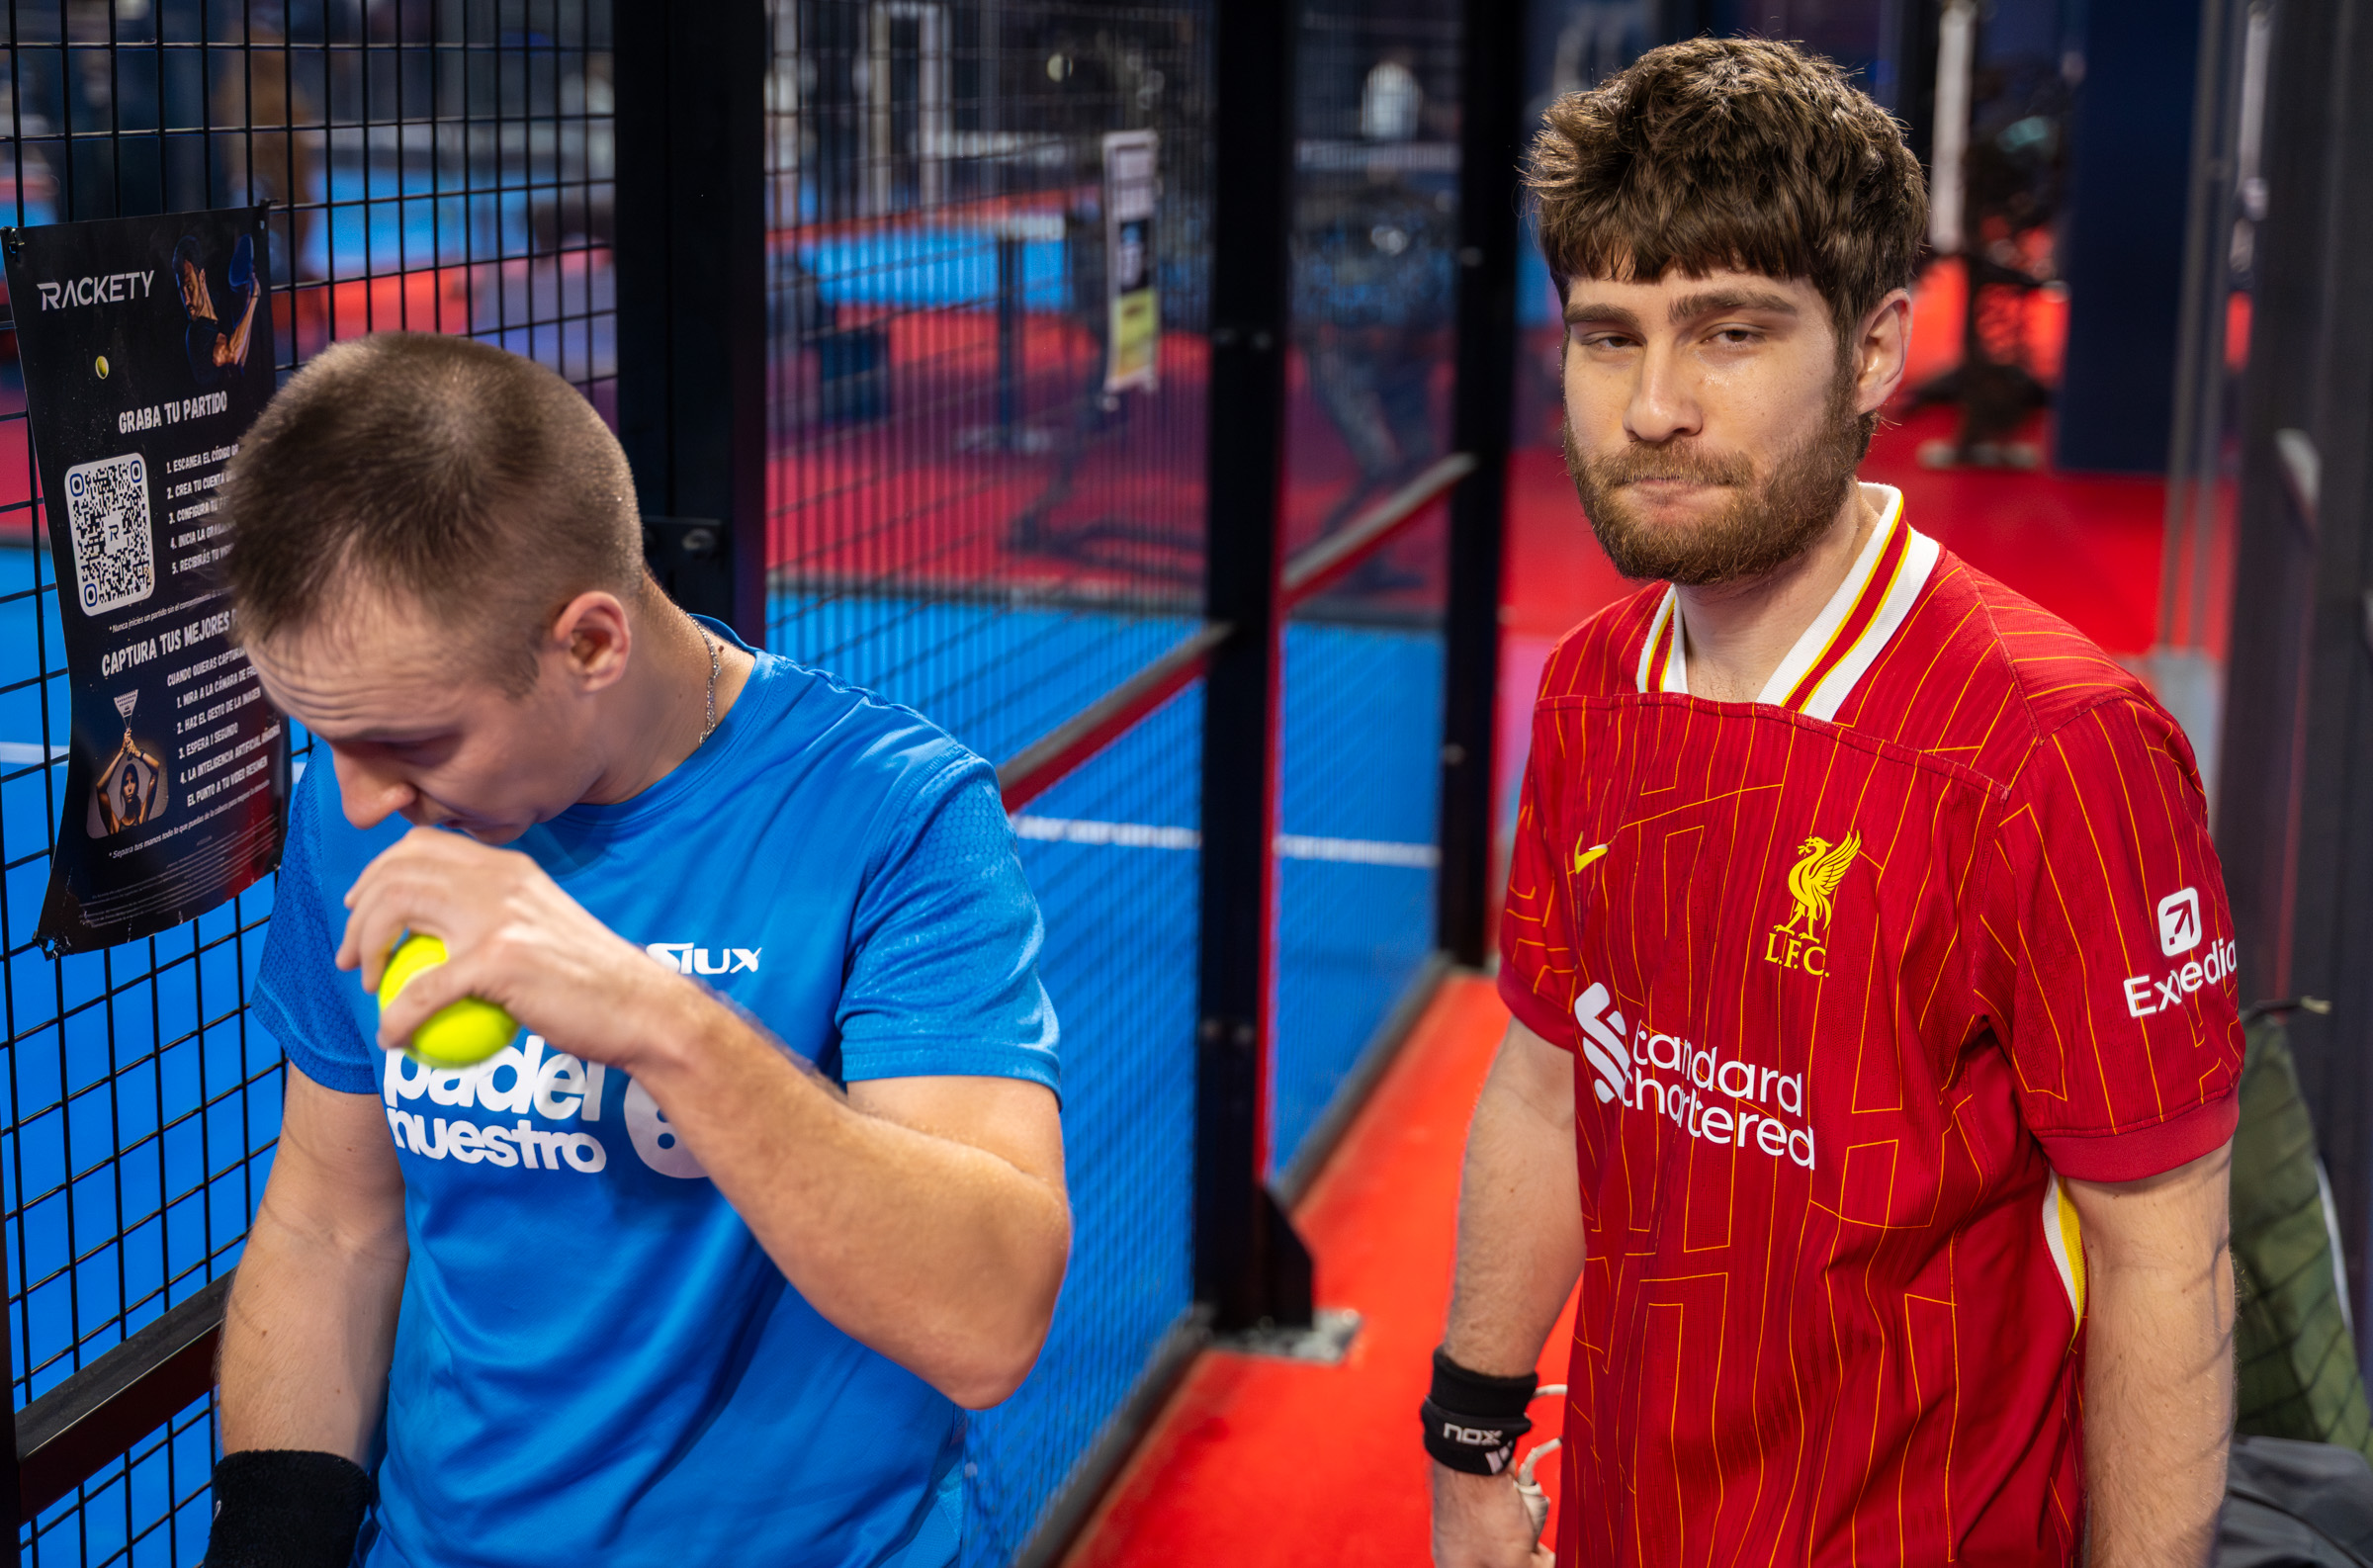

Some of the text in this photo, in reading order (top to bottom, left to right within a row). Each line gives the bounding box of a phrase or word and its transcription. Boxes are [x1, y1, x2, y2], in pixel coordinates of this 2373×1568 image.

[37, 270, 155, 311] RACKETY
[119, 391, 227, 434] GRABA TU PARTIDO
[173, 454, 202, 473] ESCANEA
[203, 451, 211, 465] EL
[175, 481, 193, 497] CREA
[193, 479, 202, 492] TU
[203, 472, 225, 489] CUENTA
[178, 531, 197, 548] INICIA
[197, 528, 206, 542] LA
[179, 549, 211, 572] RECIBIRÁS
[211, 548, 220, 562] TU
[102, 638, 157, 676] CAPTURA
[159, 629, 181, 654] TUS
[184, 610, 229, 647] MEJORES
[167, 666, 192, 687] CUANDO
[193, 656, 218, 677] QUIERAS
[183, 690, 199, 706] MIRA
[199, 687, 205, 699] A
[206, 683, 214, 697] LA
[215, 675, 238, 693] CÁMARA
[238, 668, 246, 682] DE
[184, 715, 198, 732] HAZ
[199, 712, 207, 725] EL
[207, 703, 225, 721] GESTO
[225, 699, 233, 713] DE
[233, 696, 242, 709] LA
[242, 686, 261, 705] IMAGEN
[186, 736, 210, 756] ESPERA
[214, 722, 239, 743] SEGUNDO
[187, 767, 197, 781] LA
[197, 748, 234, 777] INTELIGENCIA
[187, 794, 196, 807] EL
[196, 783, 216, 803] PUNTO
[216, 781, 222, 793] A
[221, 776, 230, 790] TU
[113, 845, 133, 859] Separa
[1764, 932, 1830, 978] L.F.C.
[384, 1035, 605, 1122] padel
[1633, 1018, 1802, 1117] tandard
[387, 1107, 607, 1174] nuestro
